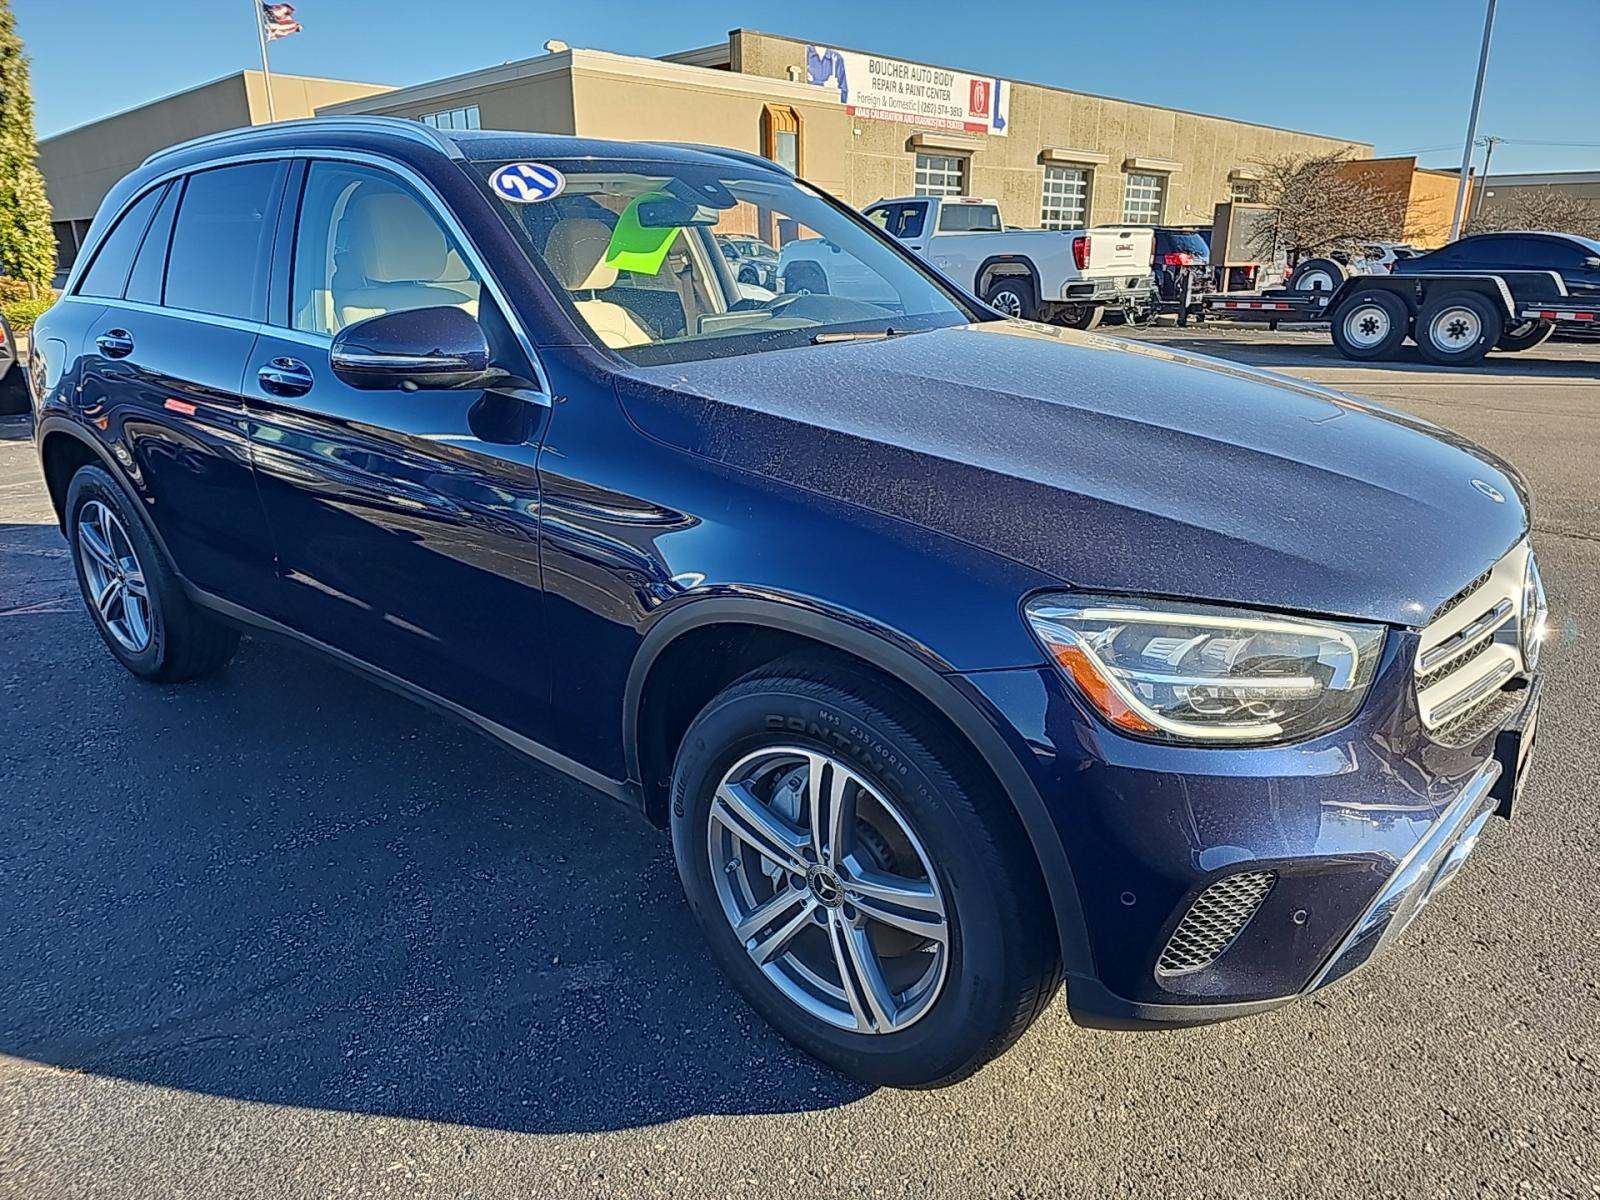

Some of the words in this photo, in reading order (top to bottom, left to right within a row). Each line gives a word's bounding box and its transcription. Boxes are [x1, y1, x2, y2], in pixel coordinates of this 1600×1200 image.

[869, 59, 909, 79] BOUCHER
[911, 67, 932, 83] AUTO
[934, 72, 954, 87] BODY
[872, 77, 896, 93] REPAIR
[898, 82, 903, 94] &
[905, 83, 925, 97] PAINT
[926, 87, 951, 101] CENTER
[857, 91, 880, 107] Foreign
[882, 96, 887, 107] &
[889, 97, 917, 111] Domestic
[920, 101, 937, 115] (262)
[946, 119, 965, 130] CENTER
[501, 165, 556, 201] 21
[818, 710, 841, 727] M+S
